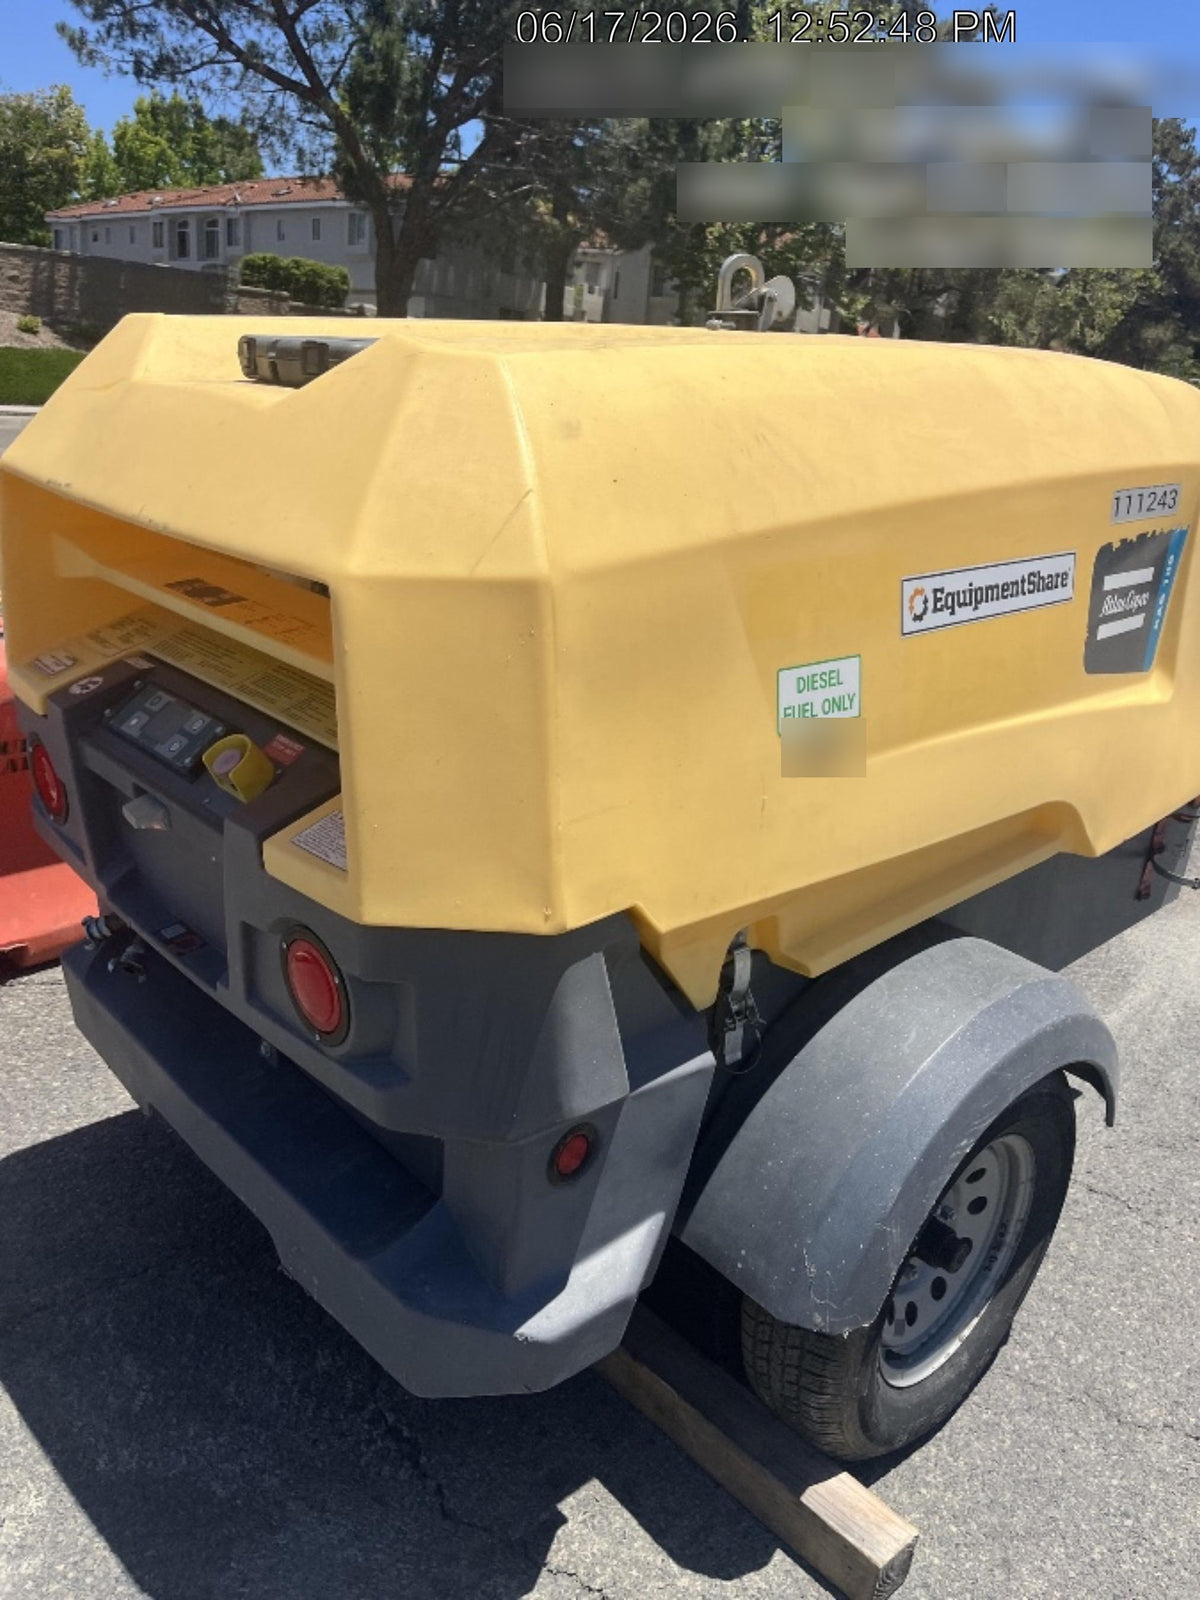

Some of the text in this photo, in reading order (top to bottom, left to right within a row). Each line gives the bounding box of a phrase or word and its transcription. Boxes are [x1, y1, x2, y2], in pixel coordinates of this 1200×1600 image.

[1114, 488, 1178, 518] 111243
[931, 569, 1070, 616] EquipmentShare
[796, 668, 844, 694] DIESEL
[783, 692, 856, 718] FUEL ONLY
